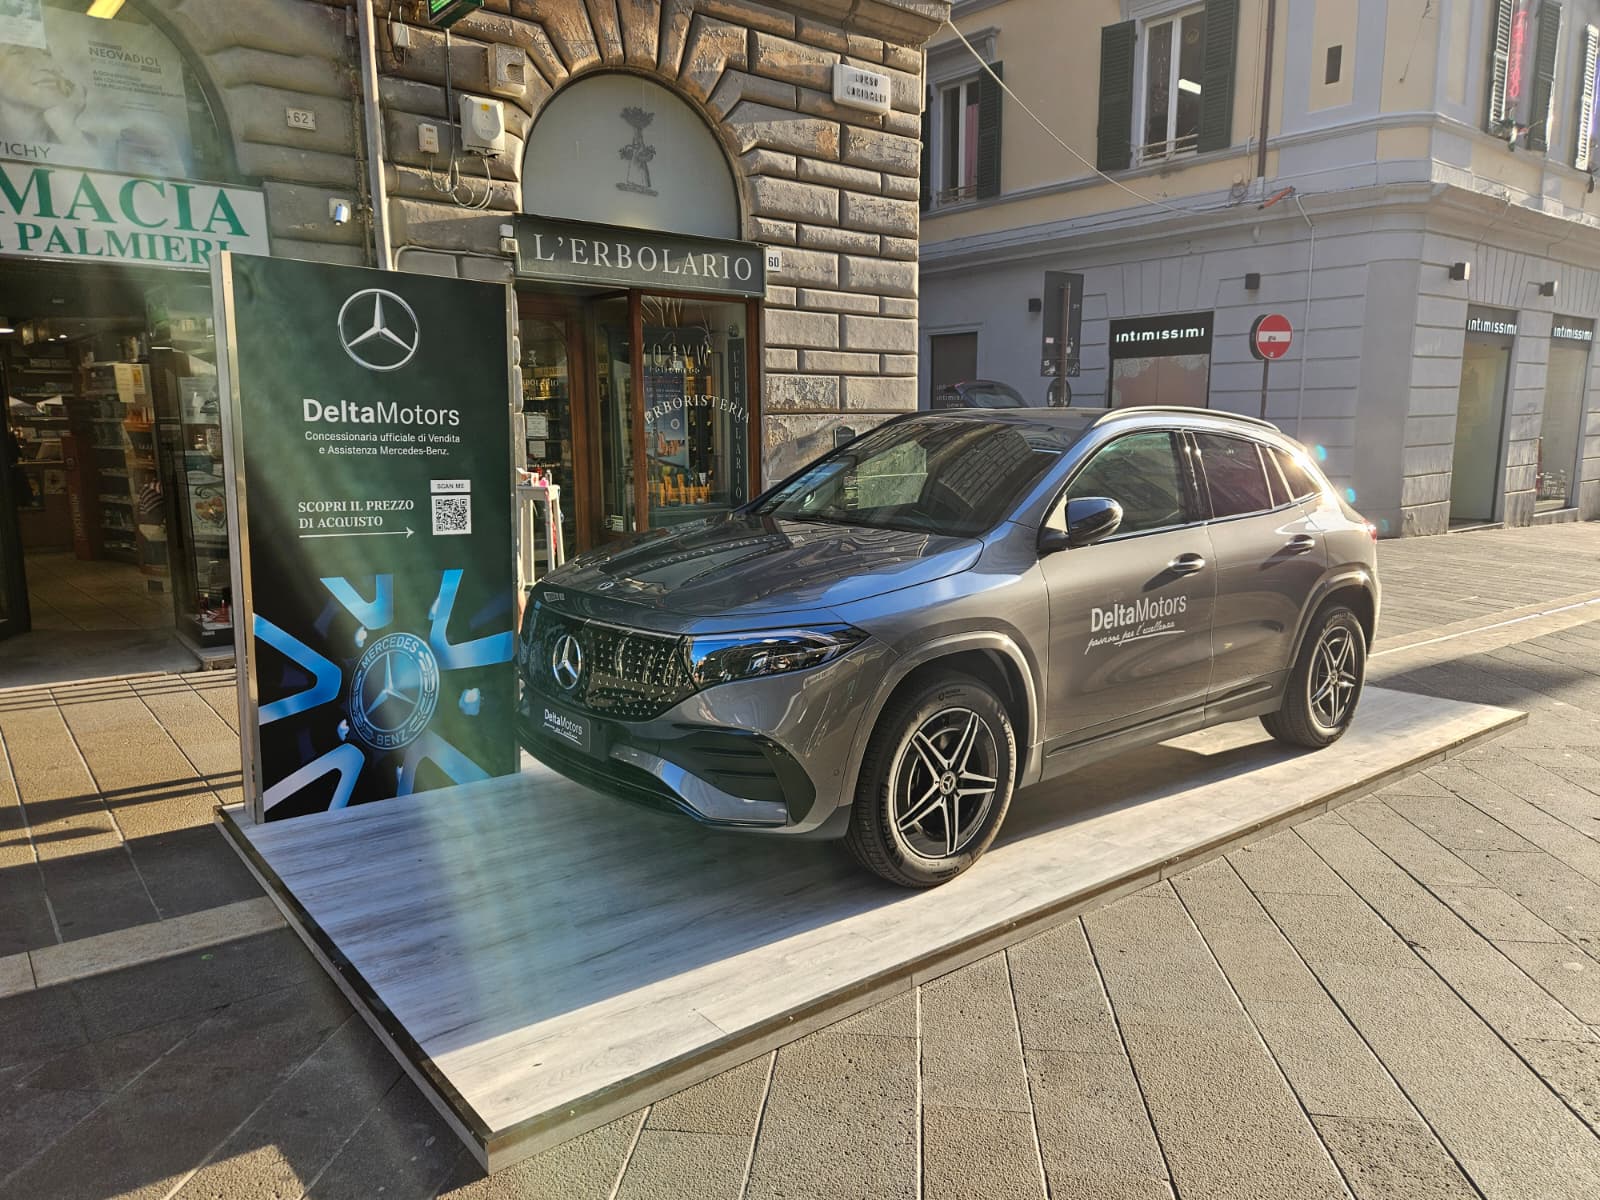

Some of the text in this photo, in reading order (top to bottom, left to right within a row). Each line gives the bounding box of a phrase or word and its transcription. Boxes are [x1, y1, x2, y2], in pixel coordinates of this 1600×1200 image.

[88, 46, 161, 67] NEOVADIOL
[293, 111, 309, 123] 62
[533, 233, 752, 281] L'ERBOLARIO
[768, 256, 780, 267] 60
[1116, 327, 1205, 343] intimissimi
[1467, 317, 1518, 335] intimissimi
[1553, 325, 1593, 341] intimissimi
[303, 398, 460, 426] DeltaMotors
[644, 394, 749, 425] ERBORISTERIA
[305, 431, 460, 443] Concessionaria ufficiale di Vendita
[327, 445, 377, 455] Assistenza
[380, 446, 449, 456] Mercedes-Benz.
[298, 499, 414, 513] SCOPRI IL PREZZO
[299, 516, 383, 529] DI ACQUISTO
[1091, 595, 1187, 633] DeltaMotors
[361, 636, 420, 669] MERCEDES
[544, 708, 583, 736] DeltaMotors
[376, 728, 409, 747] BENZ
